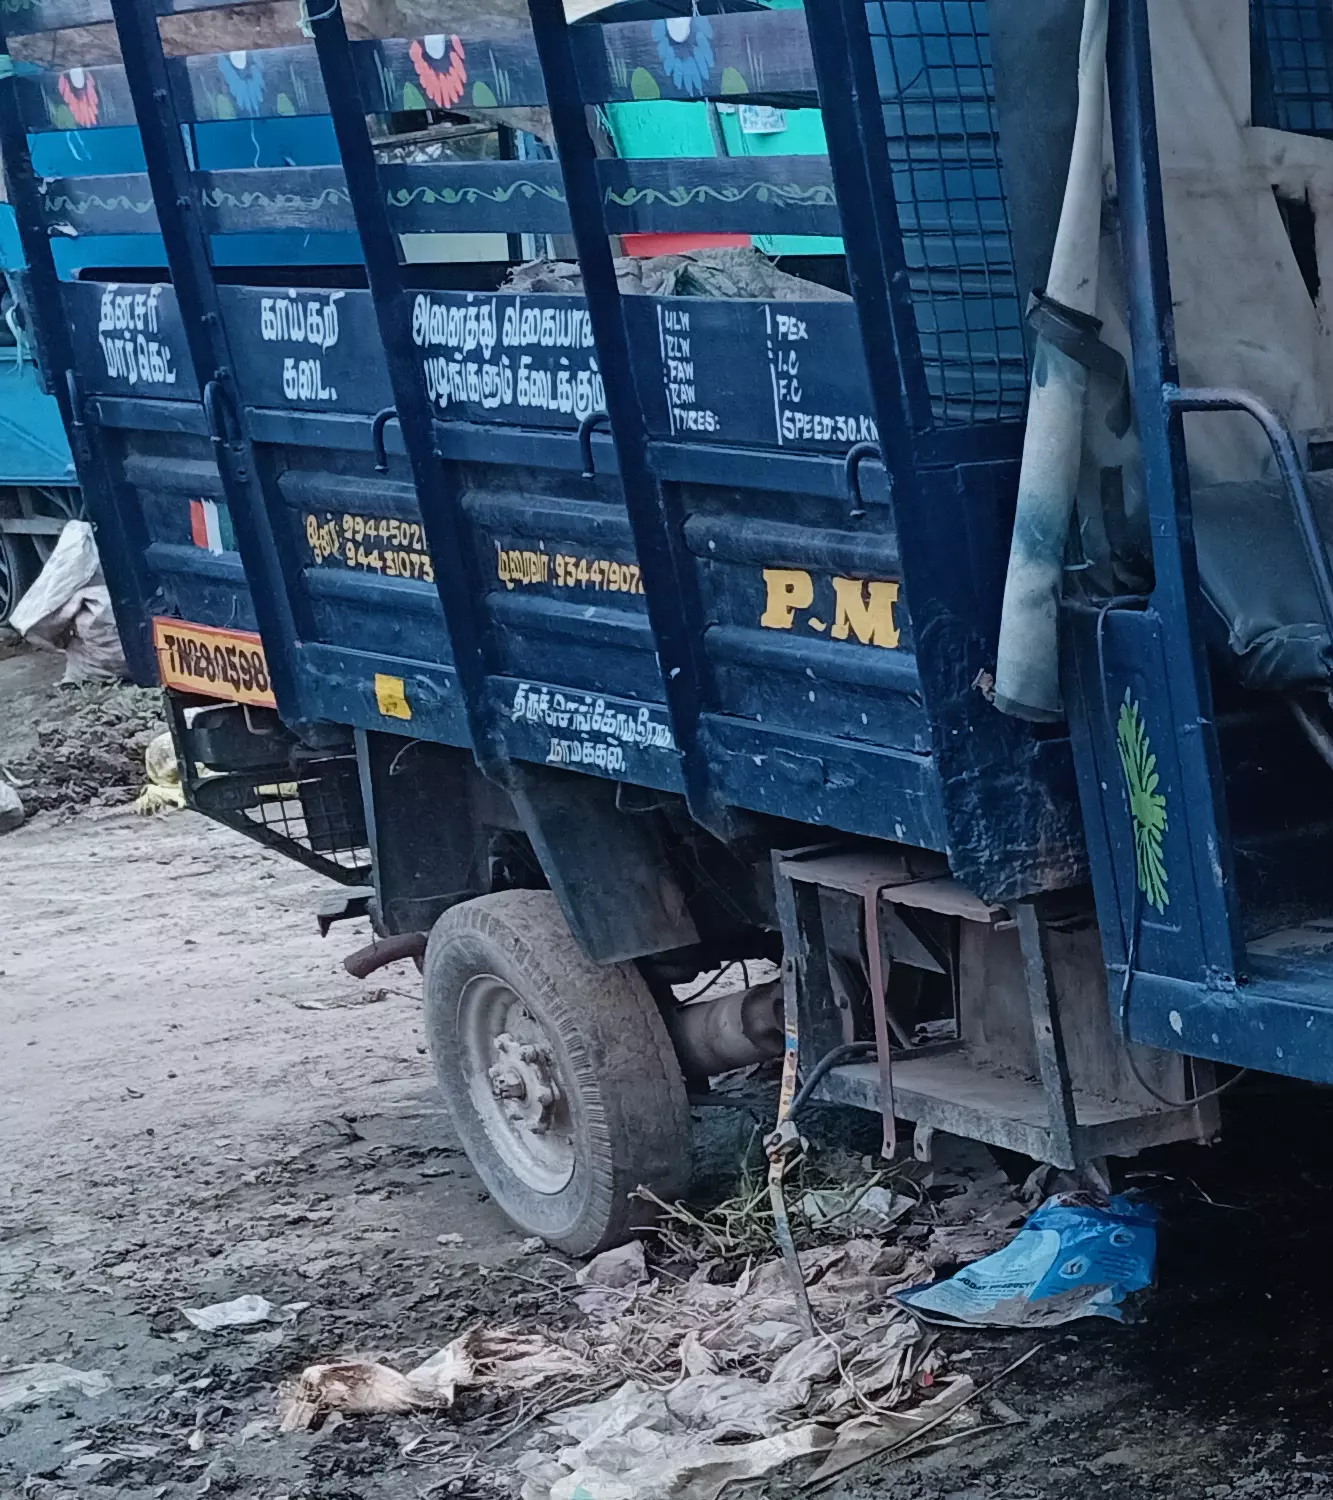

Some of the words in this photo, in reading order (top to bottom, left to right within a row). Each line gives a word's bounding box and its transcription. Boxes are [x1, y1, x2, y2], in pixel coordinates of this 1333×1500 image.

[261, 288, 345, 355] காய்கறி
[412, 294, 497, 360] அனைத்து
[664, 309, 690, 332] ULW
[667, 360, 694, 383] FAW
[669, 383, 696, 405] RAW
[554, 553, 646, 595] 93447907
